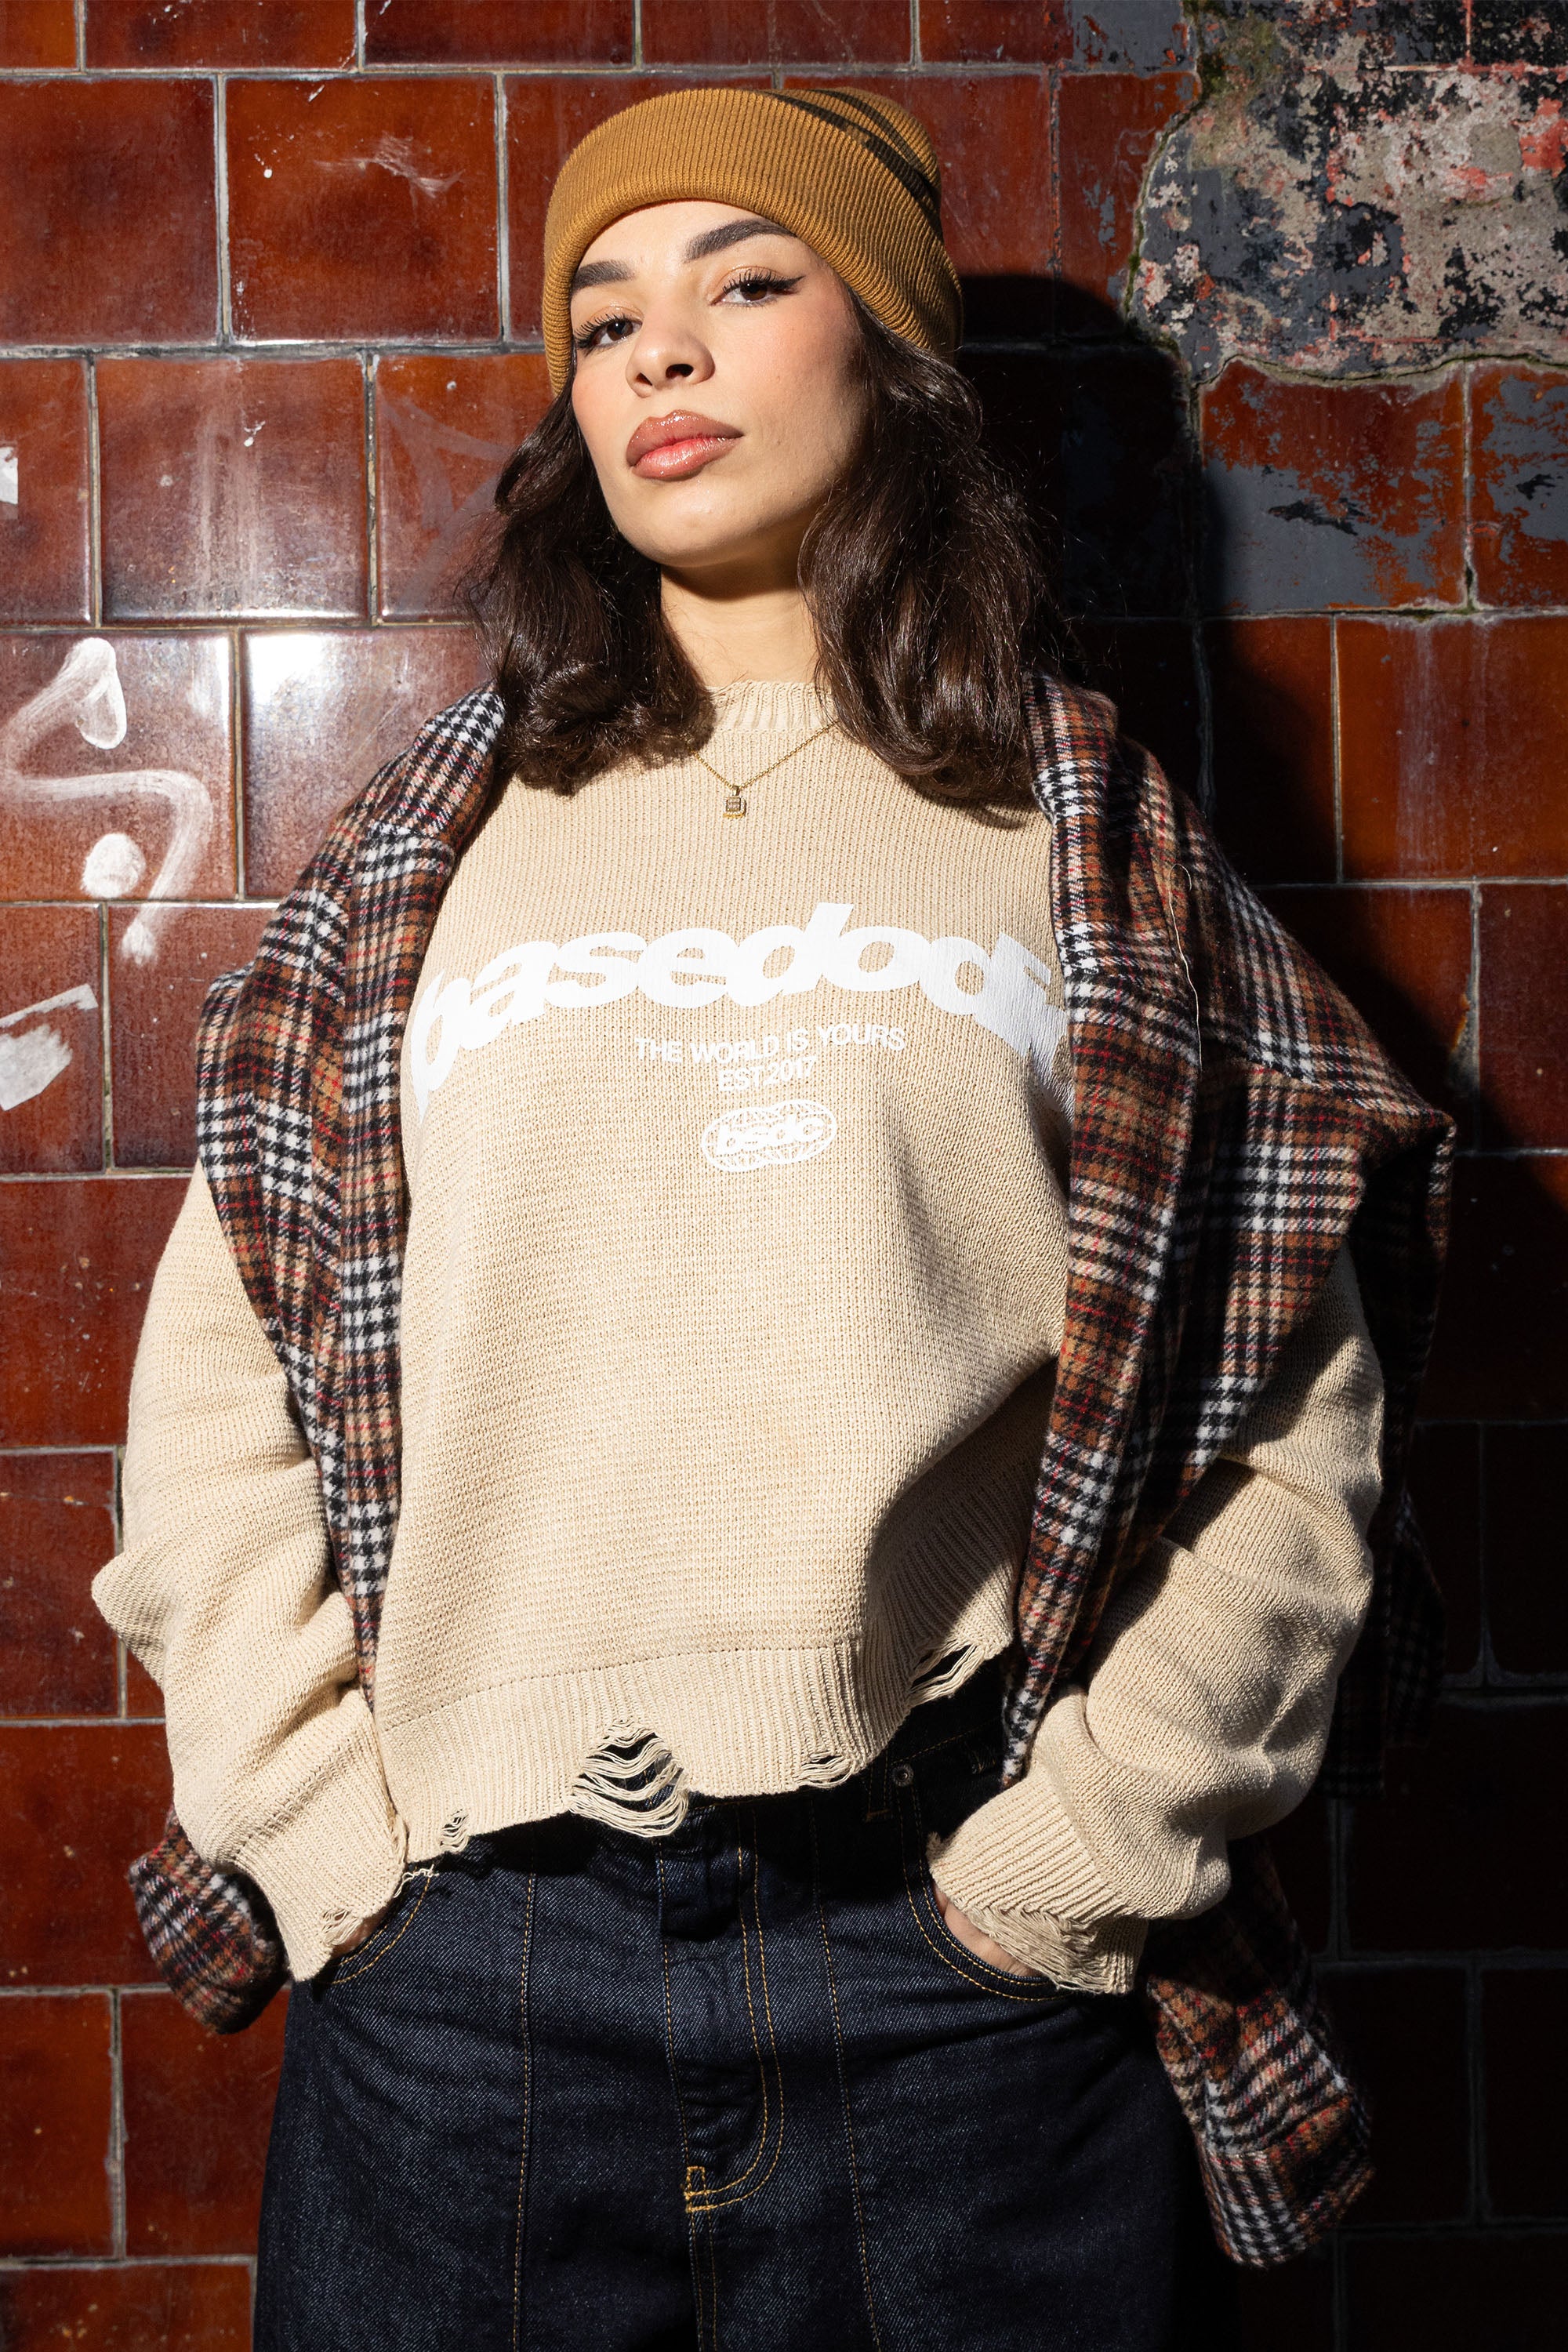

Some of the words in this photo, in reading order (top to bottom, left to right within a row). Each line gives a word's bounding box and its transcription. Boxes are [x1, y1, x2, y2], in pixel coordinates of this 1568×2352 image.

[635, 1037, 683, 1063] THE
[690, 1034, 780, 1065] WORLD
[786, 1027, 810, 1054] IS
[816, 1022, 907, 1051] YOURS
